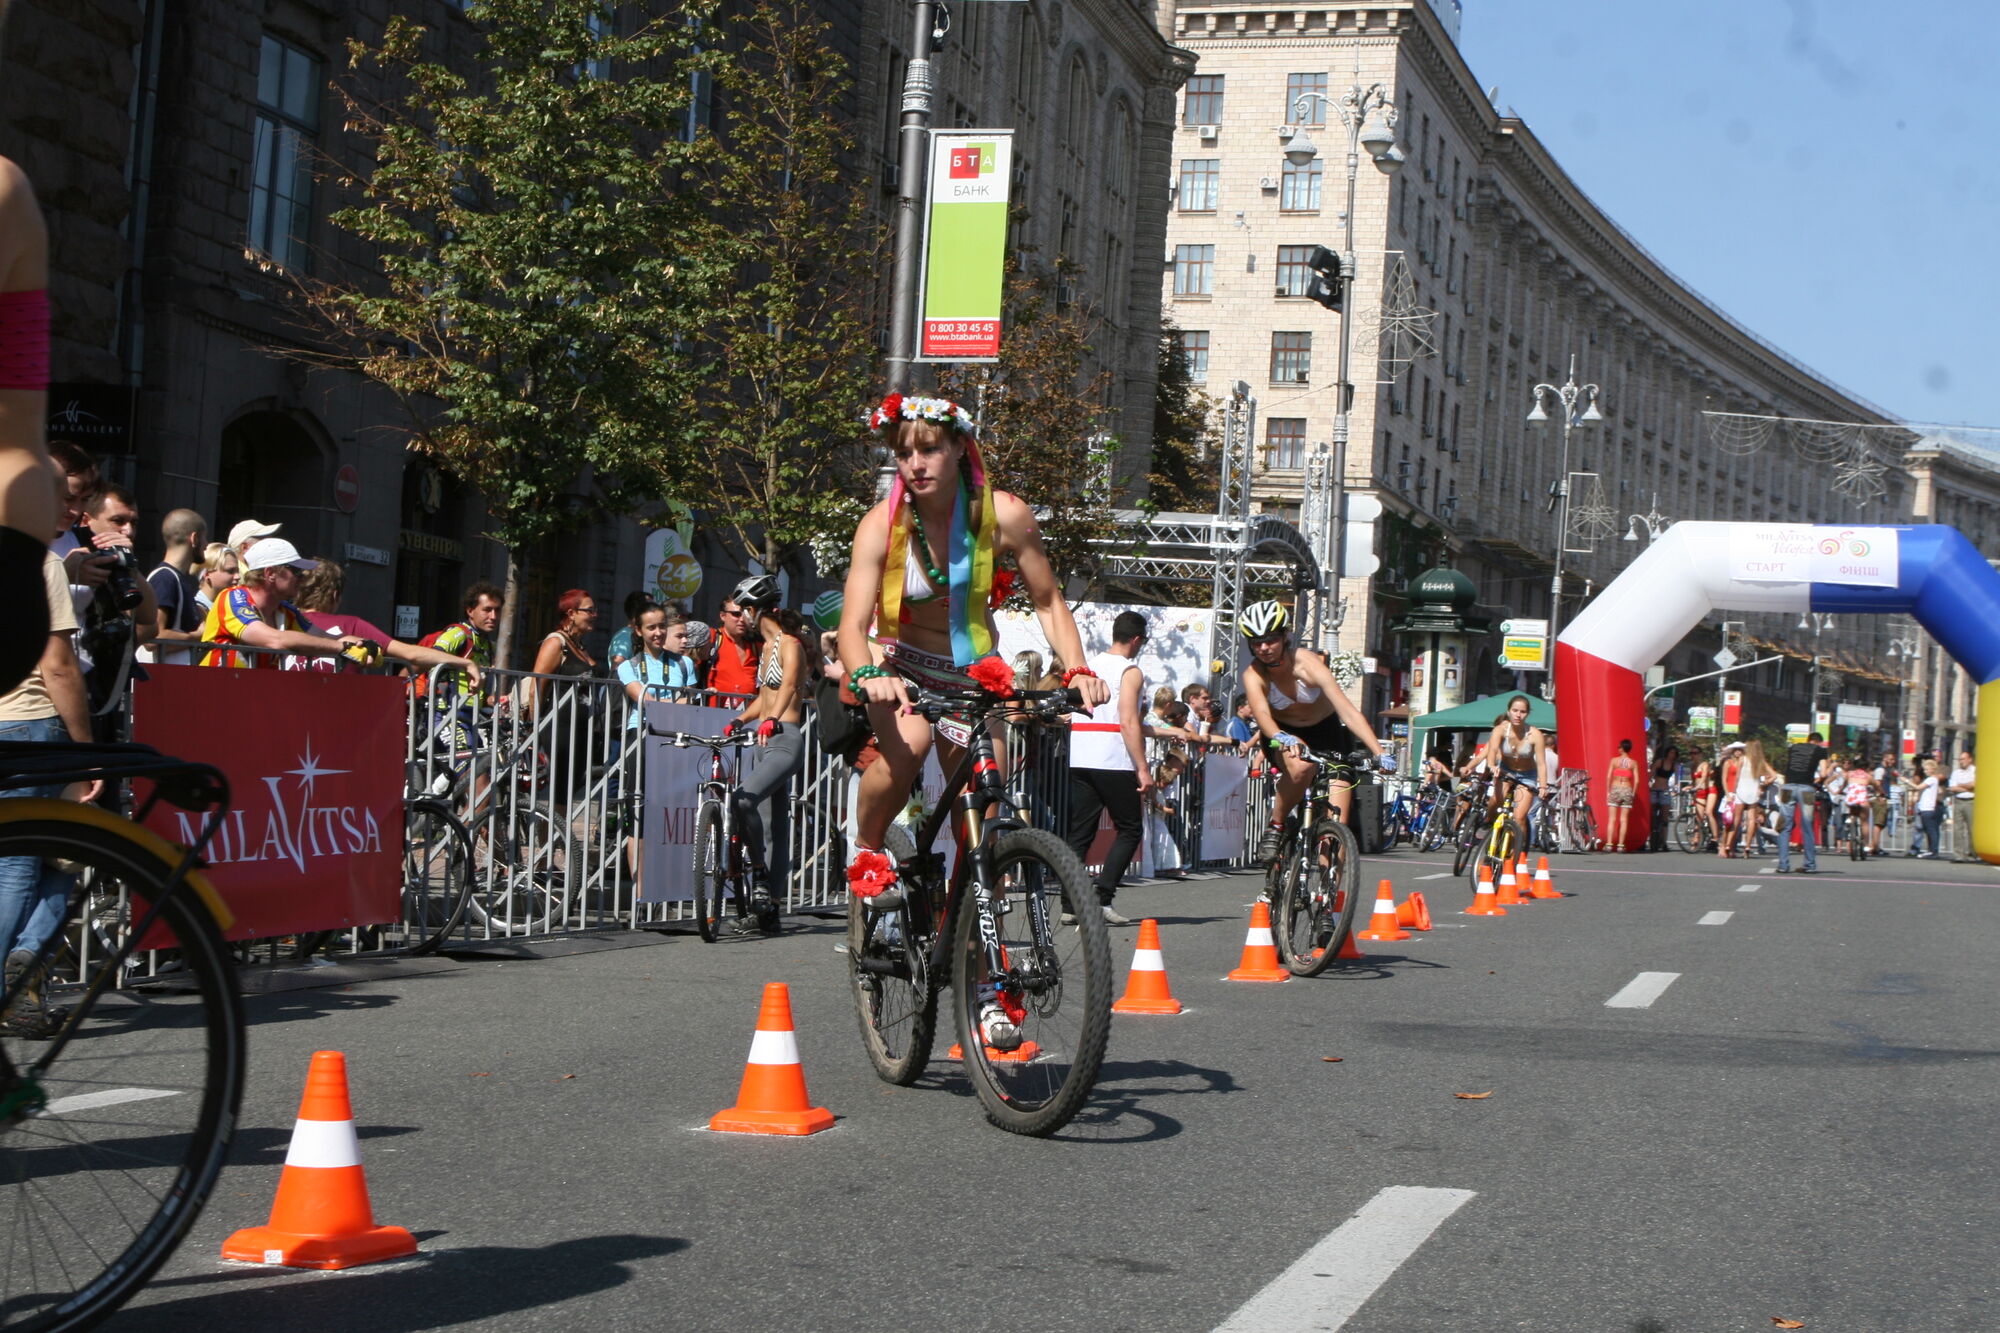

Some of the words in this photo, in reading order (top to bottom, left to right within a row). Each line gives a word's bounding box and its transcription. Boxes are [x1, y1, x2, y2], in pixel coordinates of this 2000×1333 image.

[952, 155, 994, 168] БТА
[953, 184, 990, 197] БАНК
[930, 323, 936, 333] 0
[937, 323, 955, 333] 800
[956, 323, 968, 333] 30
[969, 323, 981, 333] 45
[982, 323, 994, 333] 45
[929, 333, 994, 341] www.btabank.ua
[661, 562, 688, 582] 24
[1746, 562, 1787, 572] СТАРТ
[174, 776, 382, 874] MILAVITSA
